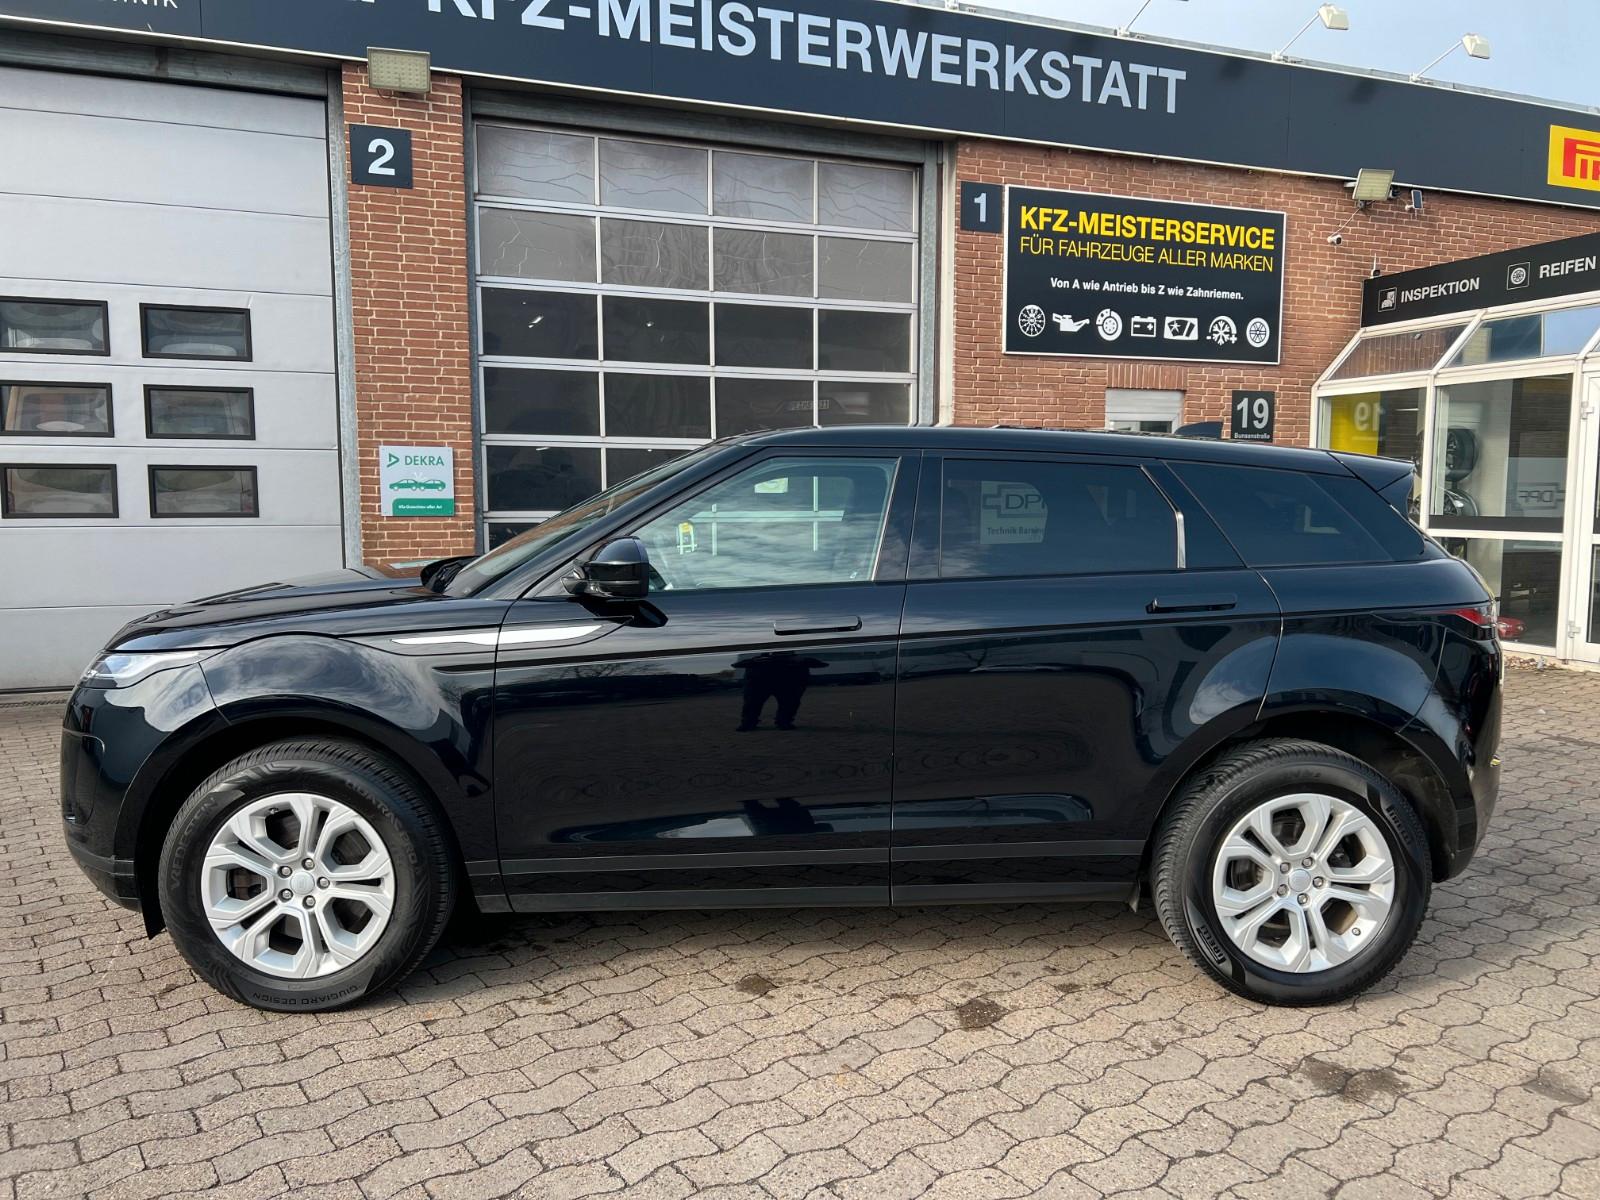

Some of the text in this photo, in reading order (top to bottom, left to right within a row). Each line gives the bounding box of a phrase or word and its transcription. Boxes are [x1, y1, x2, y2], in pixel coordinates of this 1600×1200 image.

[427, 0, 1187, 114] Z-MEISTERWERKSTATT
[367, 138, 396, 176] 2
[974, 192, 988, 223] 1
[1020, 205, 1275, 250] KFZ-MEISTERSERVICE
[1020, 233, 1274, 273] FÜR FAHRZEUGE ALLER MARKEN
[1539, 255, 1597, 280] REIFEN
[1050, 277, 1245, 301] Von A wie Antrieb bis Z wie Zahnriemen.
[1400, 277, 1480, 304] INSPEKTION
[1237, 398, 1269, 429] 19
[404, 455, 445, 466] DEKRA
